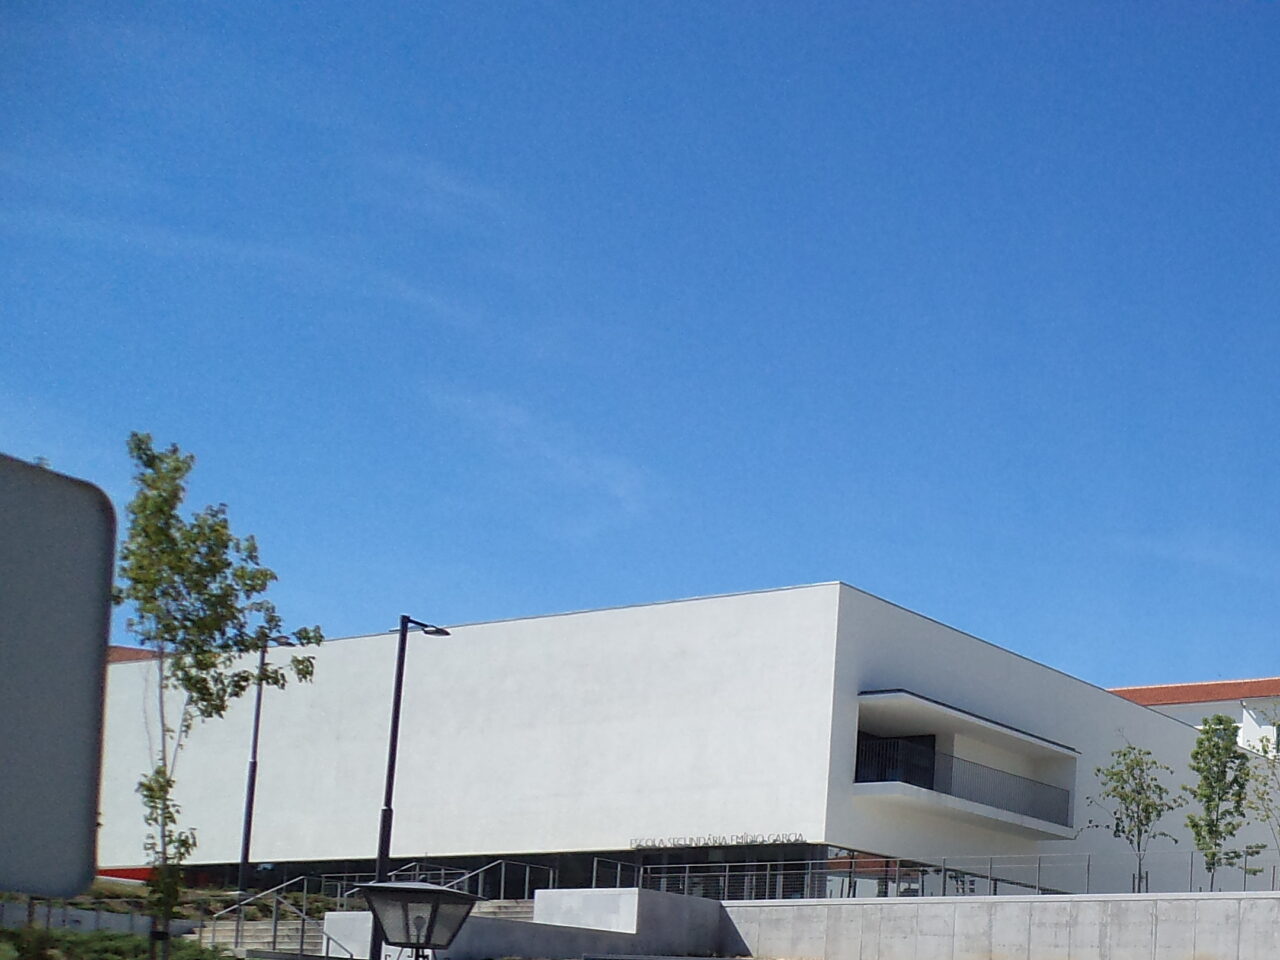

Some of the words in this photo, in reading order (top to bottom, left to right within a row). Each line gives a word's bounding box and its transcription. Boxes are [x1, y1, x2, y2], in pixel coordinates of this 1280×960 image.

[630, 838, 665, 849] ESCOLA
[667, 833, 728, 848] SECUNDÁRIA
[730, 832, 766, 846] EMÍDIO
[767, 832, 804, 844] GARCIA
